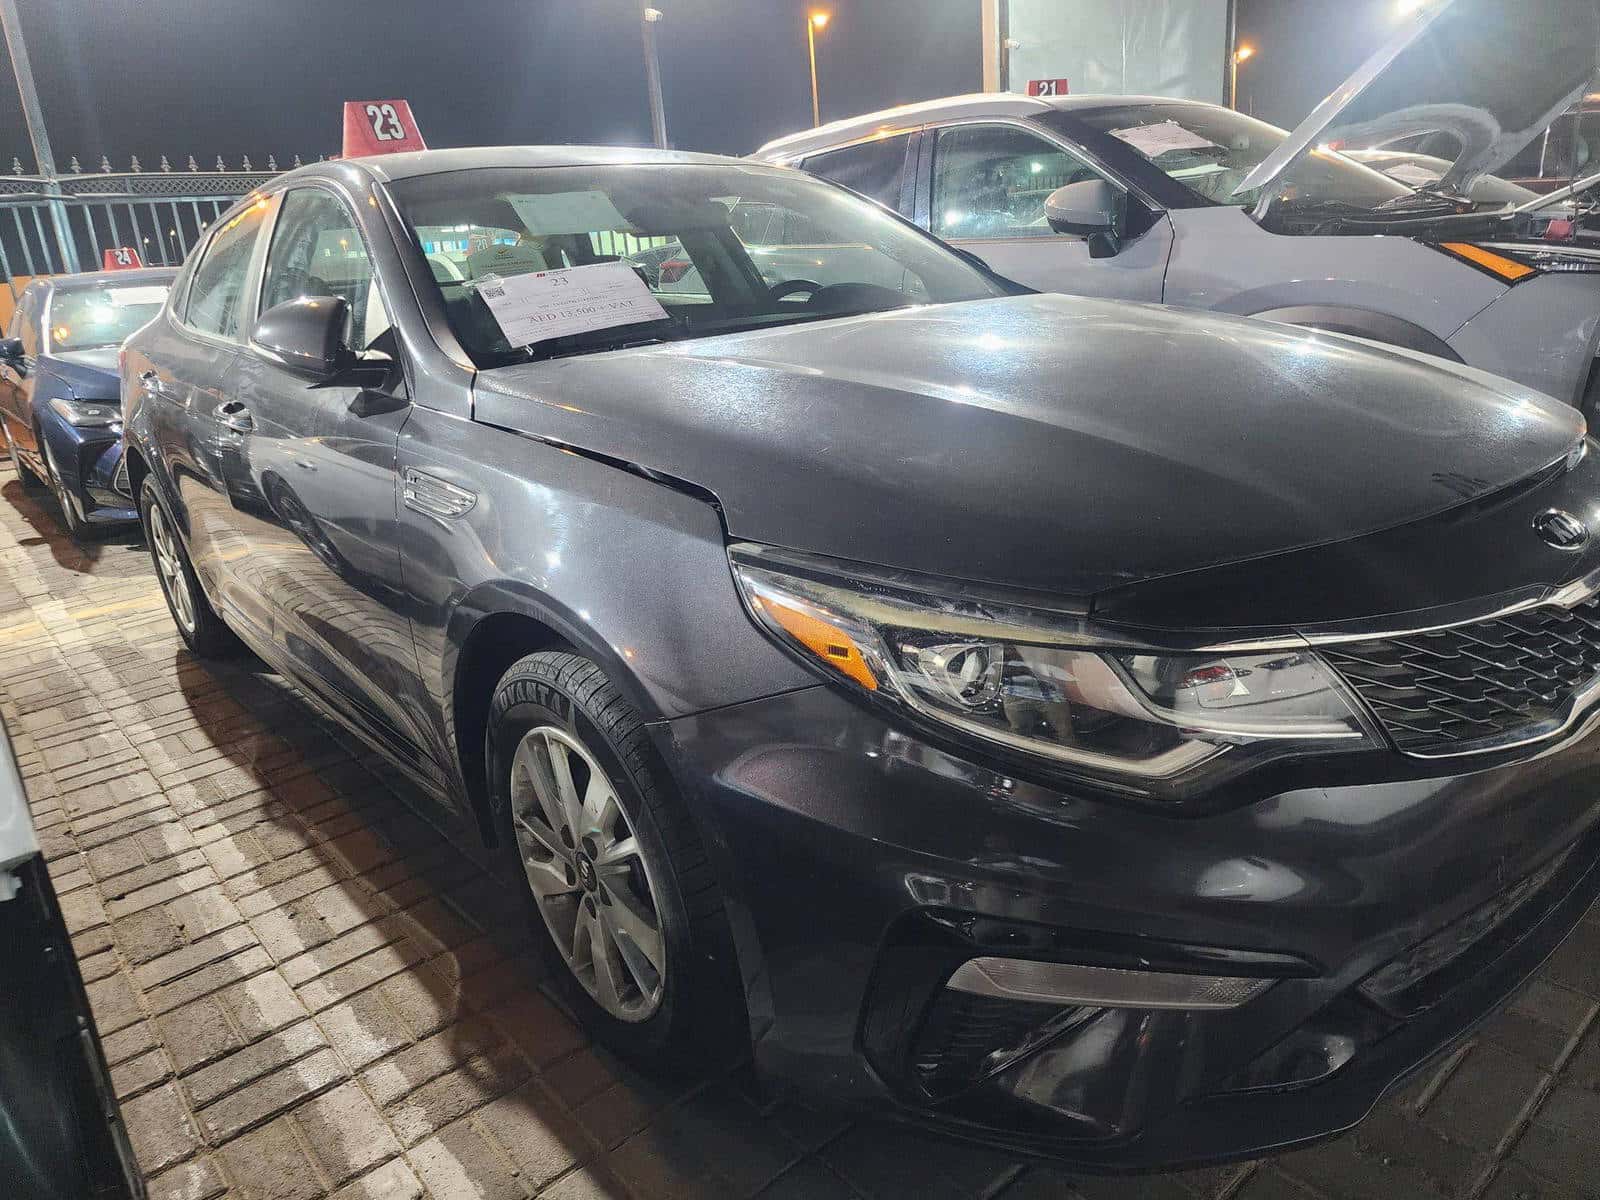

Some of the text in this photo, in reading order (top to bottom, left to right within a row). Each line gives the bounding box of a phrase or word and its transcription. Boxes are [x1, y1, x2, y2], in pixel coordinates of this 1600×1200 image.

[1039, 81, 1057, 96] 21
[366, 104, 405, 141] 23
[114, 249, 132, 265] 24
[528, 311, 557, 323] AED
[560, 306, 596, 318] 13,500
[608, 300, 634, 310] VAT
